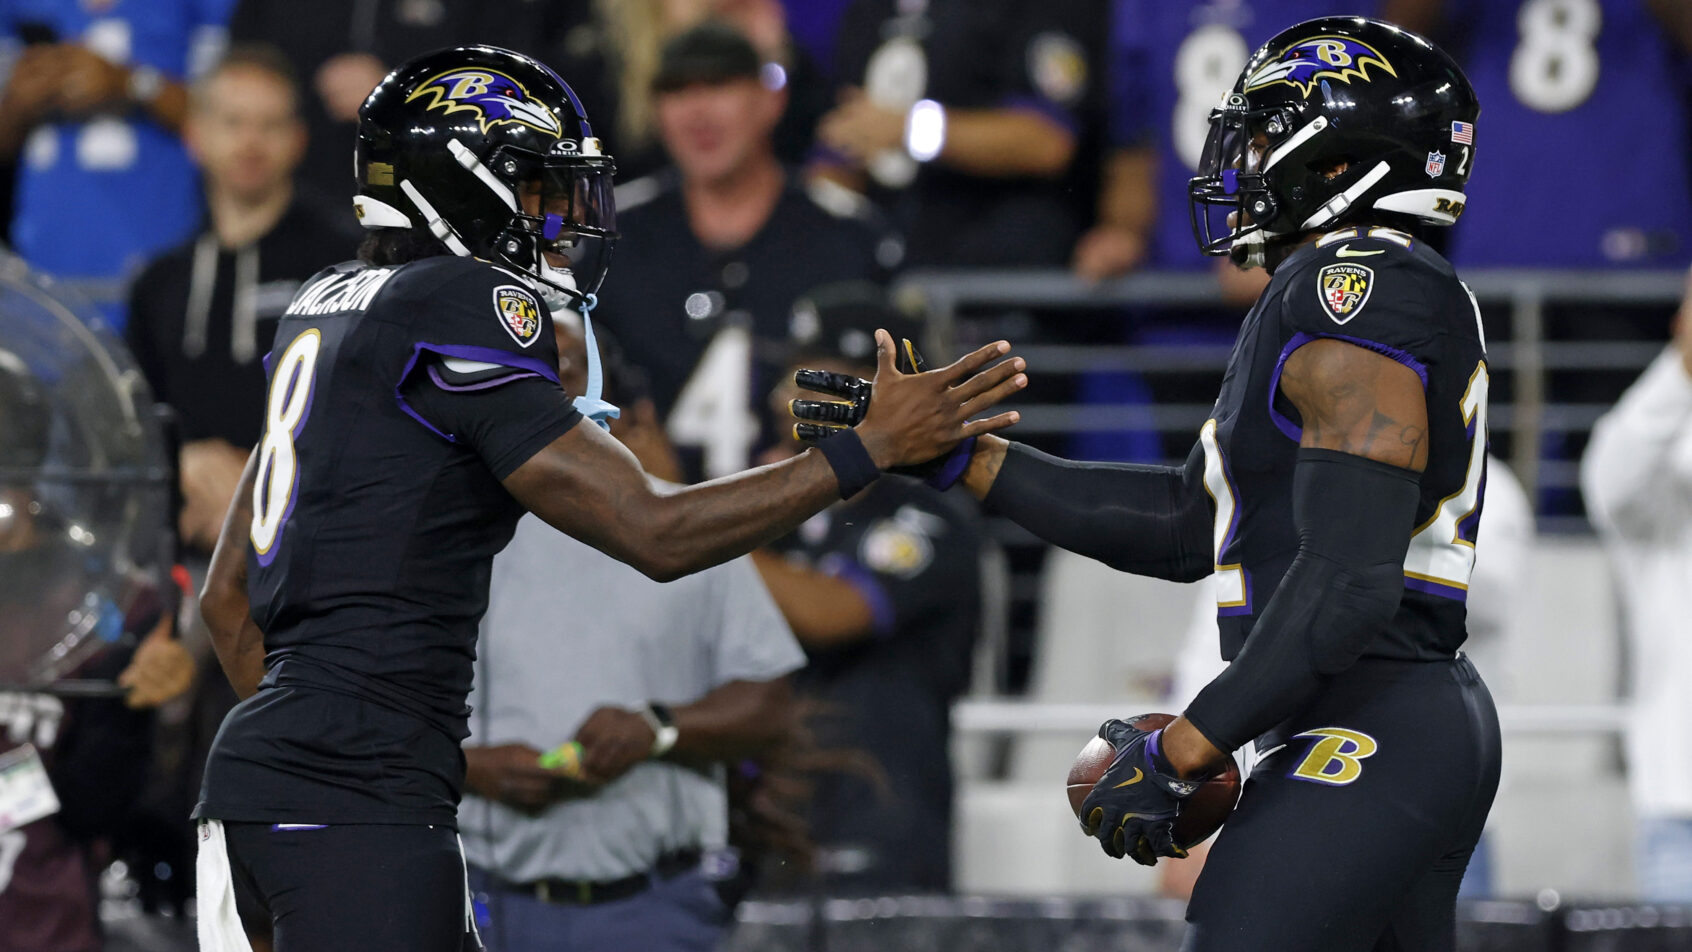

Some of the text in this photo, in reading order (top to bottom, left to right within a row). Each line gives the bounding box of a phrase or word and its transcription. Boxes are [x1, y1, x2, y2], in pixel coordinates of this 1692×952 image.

[1508, 0, 1602, 113] 8
[499, 290, 534, 306] RAVENS
[1326, 267, 1367, 278] RAVENS
[250, 328, 319, 562] 8
[666, 326, 762, 482] 4
